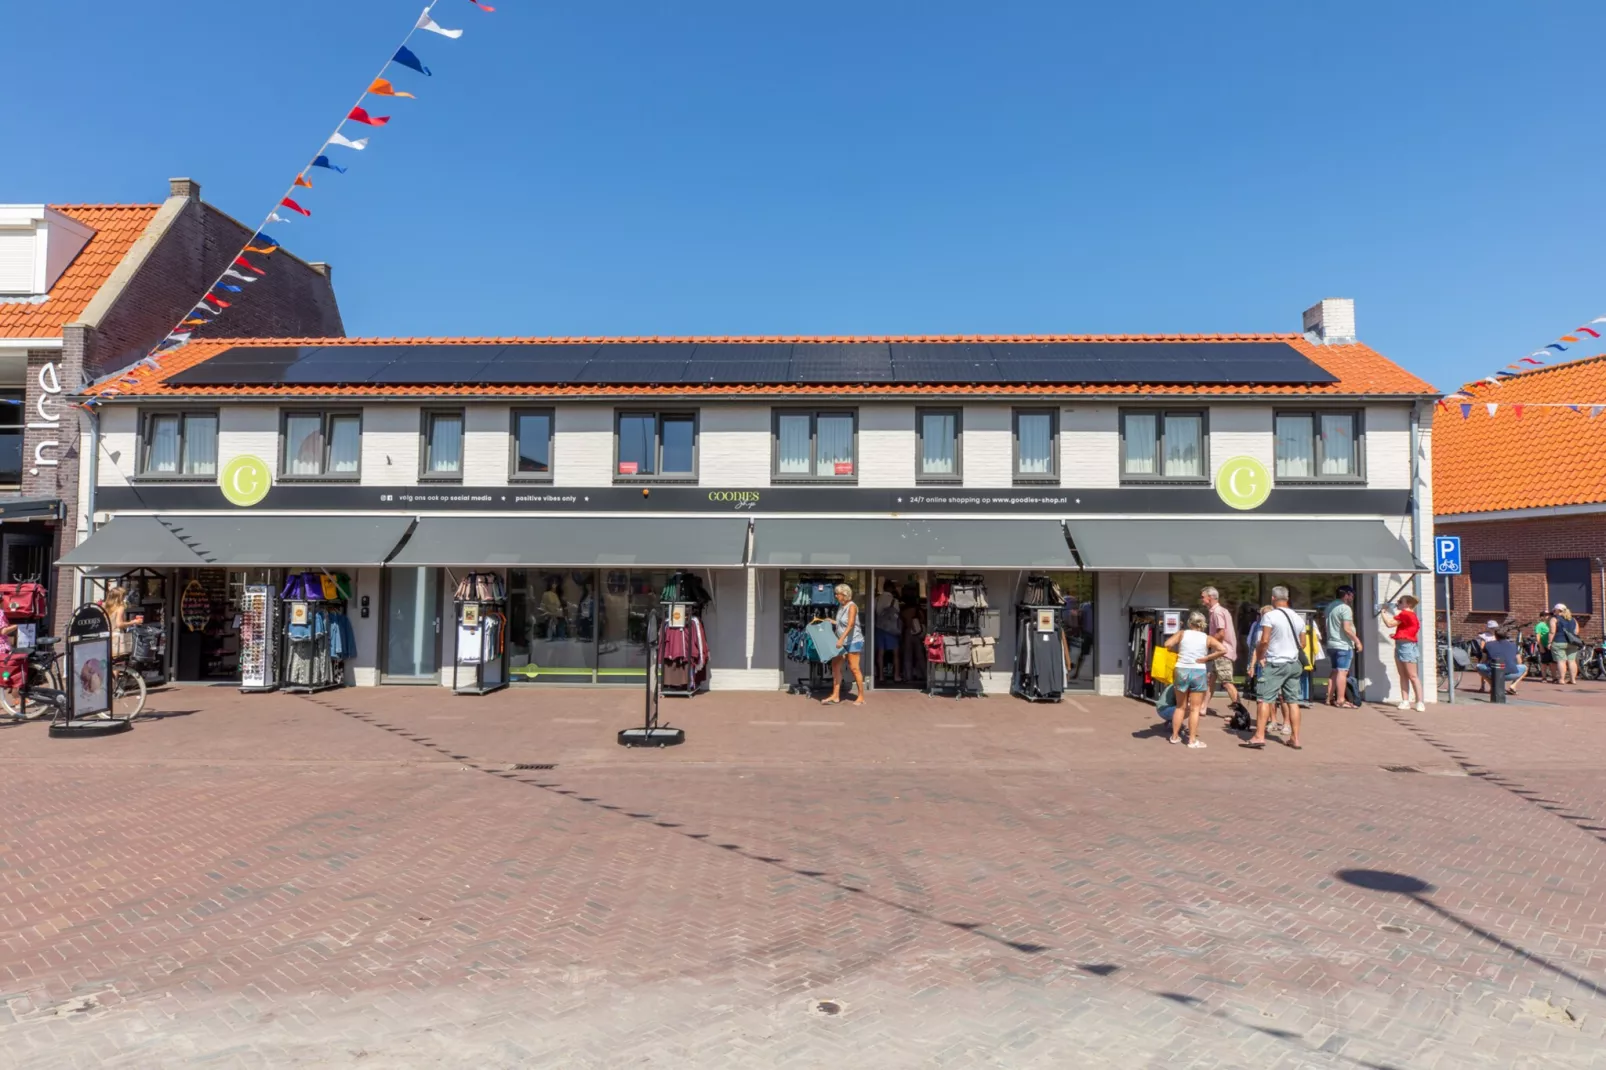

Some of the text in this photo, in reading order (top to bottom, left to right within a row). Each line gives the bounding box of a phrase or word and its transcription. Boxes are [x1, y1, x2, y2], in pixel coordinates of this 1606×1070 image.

[233, 465, 258, 496] G
[1230, 466, 1256, 498] G
[515, 494, 542, 502] positive
[562, 494, 577, 503] only
[708, 491, 760, 501] GOODIES
[948, 496, 980, 504] shopping
[992, 496, 1067, 504] www.goodies-shop.nl
[1441, 540, 1455, 559] P
